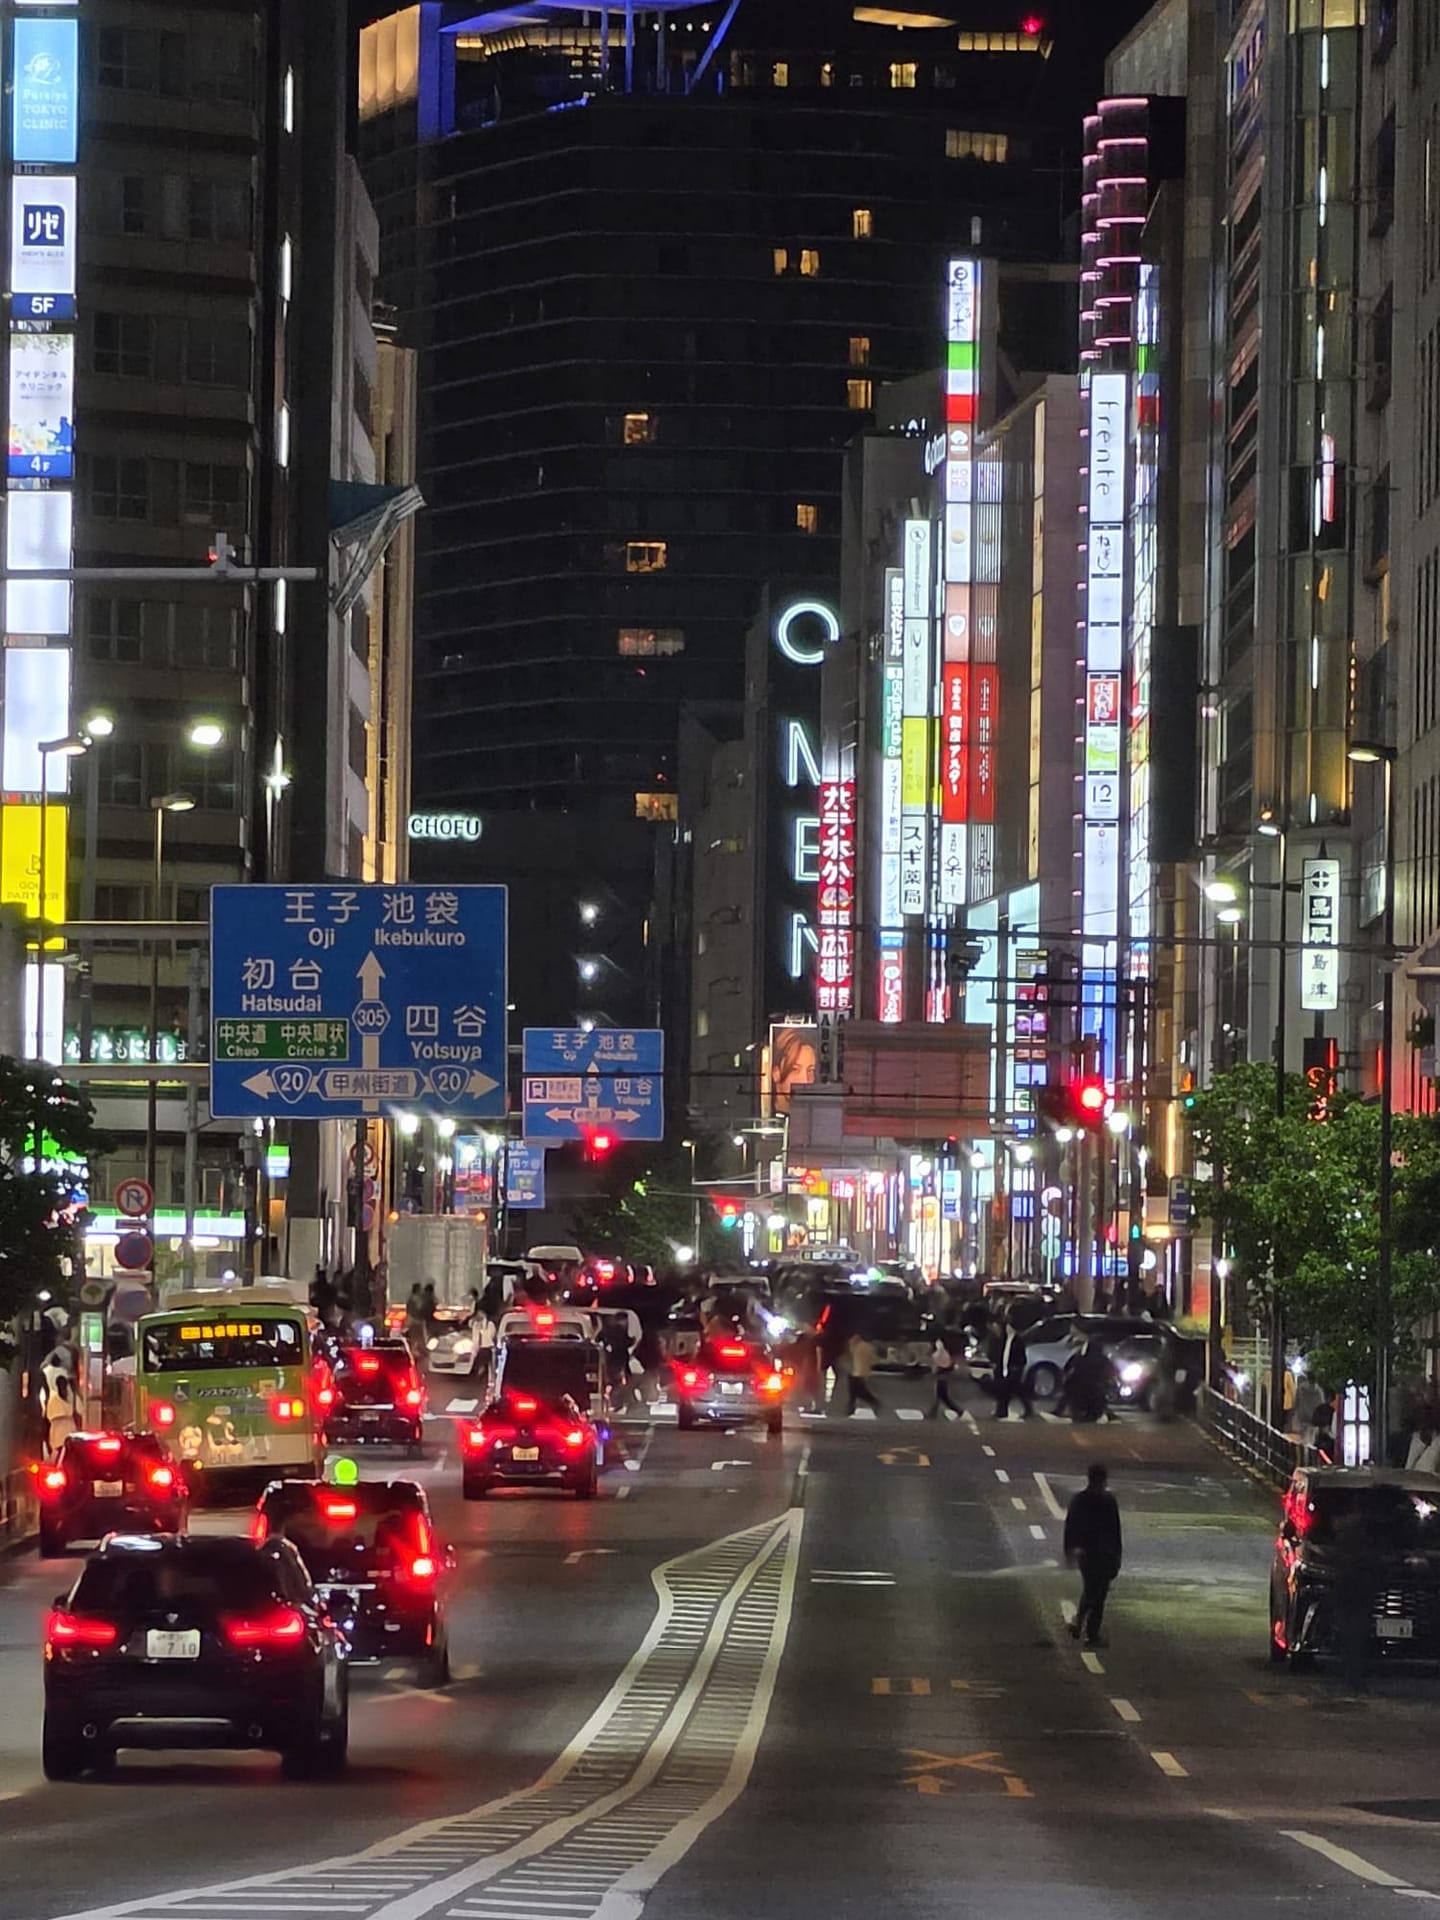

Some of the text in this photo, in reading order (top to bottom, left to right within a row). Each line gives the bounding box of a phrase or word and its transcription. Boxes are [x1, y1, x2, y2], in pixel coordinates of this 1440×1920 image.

[23, 119, 67, 129] CLINIC
[28, 211, 59, 240] リゼ
[31, 297, 55, 313] 5F
[31, 456, 51, 472] 4F
[408, 815, 482, 841] CHOFU
[904, 826, 923, 904] スギ薬局
[285, 892, 459, 925] 王子 池袋
[308, 928, 465, 949] Oji Ikebukuro
[241, 957, 323, 991] 初台
[241, 995, 322, 1012] Hatsudai
[357, 1009, 385, 1026] 305
[406, 1005, 486, 1037] 四谷
[219, 1022, 344, 1044] 中央道 中央環状
[552, 1033, 589, 1049] 王子
[226, 1044, 338, 1056] Chuo Circle 2
[411, 1042, 482, 1061] Yotsuya
[280, 1072, 304, 1091] 20
[332, 1074, 410, 1094] 甲州街道
[438, 1072, 461, 1091] 20
[614, 1078, 652, 1095] 四谷
